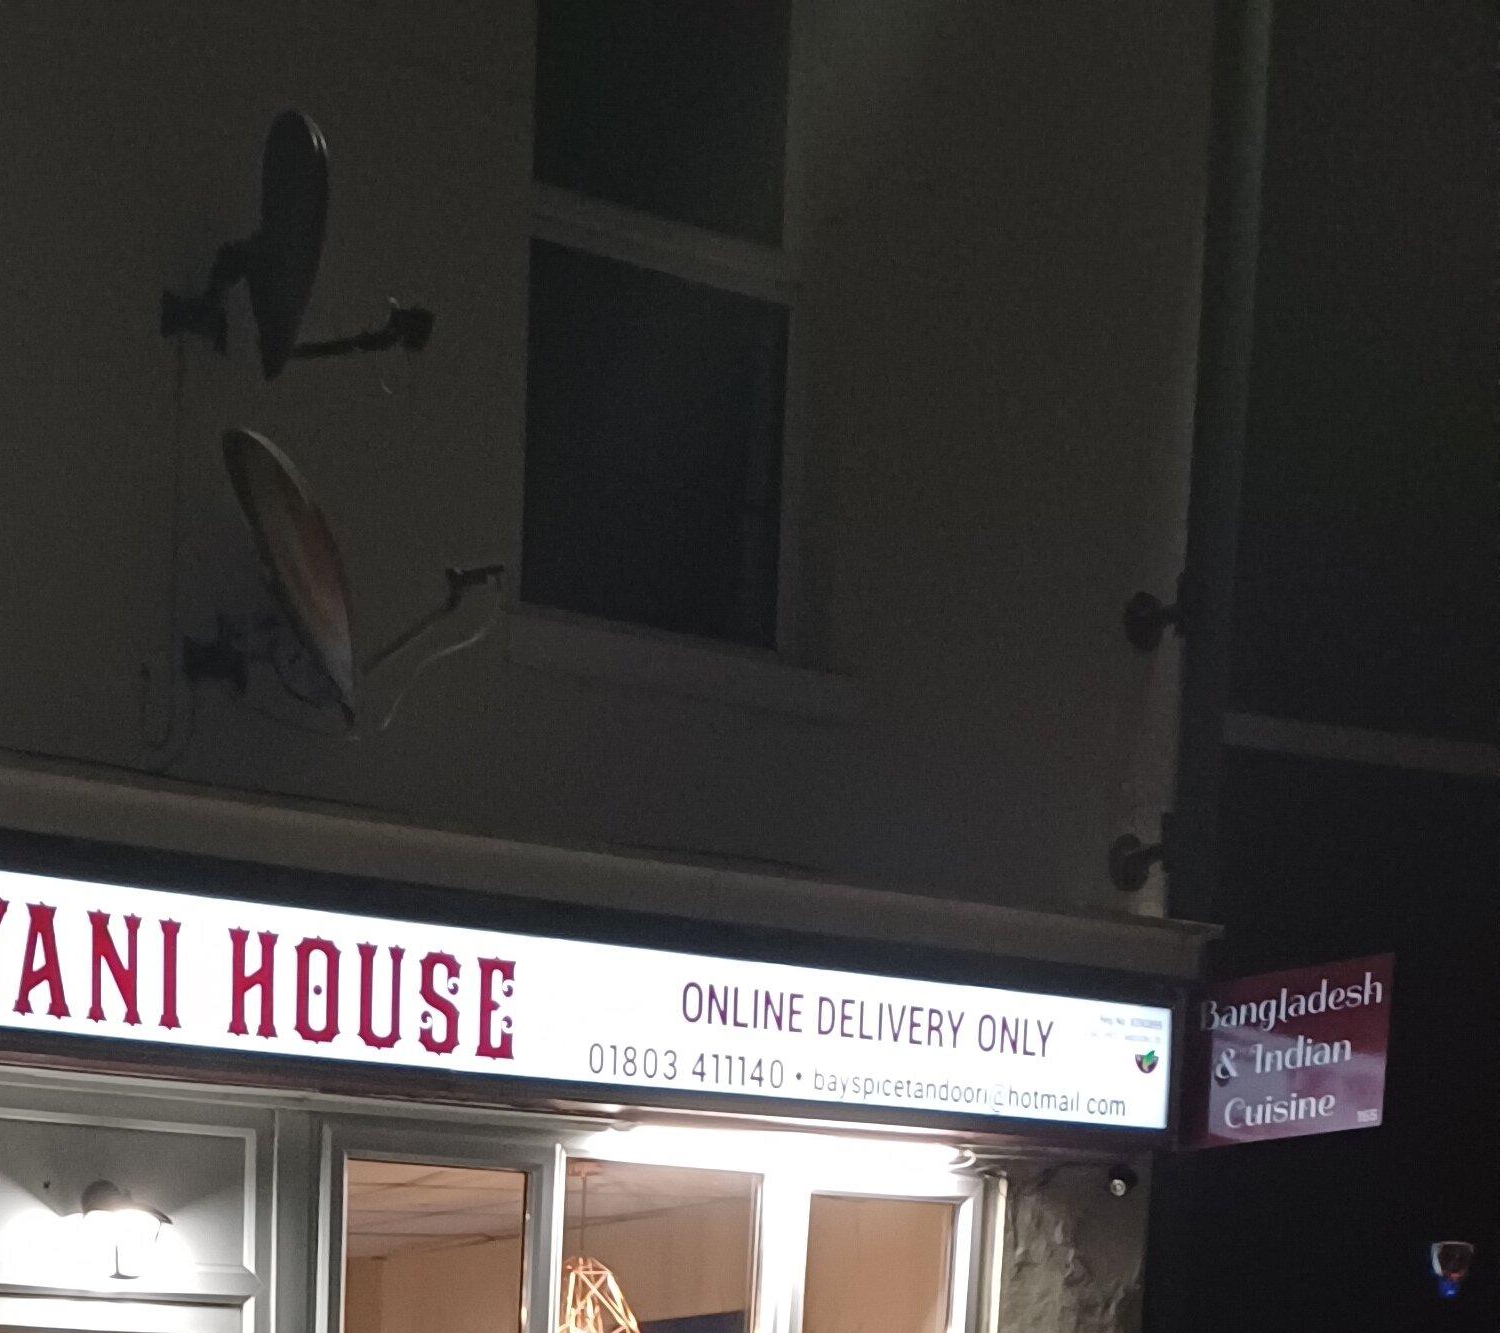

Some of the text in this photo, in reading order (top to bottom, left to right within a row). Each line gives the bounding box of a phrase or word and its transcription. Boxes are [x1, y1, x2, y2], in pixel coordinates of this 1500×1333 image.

[226, 926, 517, 1061] HOUSE
[682, 981, 1055, 1058] ONLINE DELIVERY ONLY
[1201, 971, 1383, 1031] Bangladesh
[589, 1043, 1126, 1117] 01803 411140 bayspicetandoori@hotmailcom
[1214, 1035, 1352, 1080] & Indian
[1224, 1092, 1336, 1129] Cuisine
